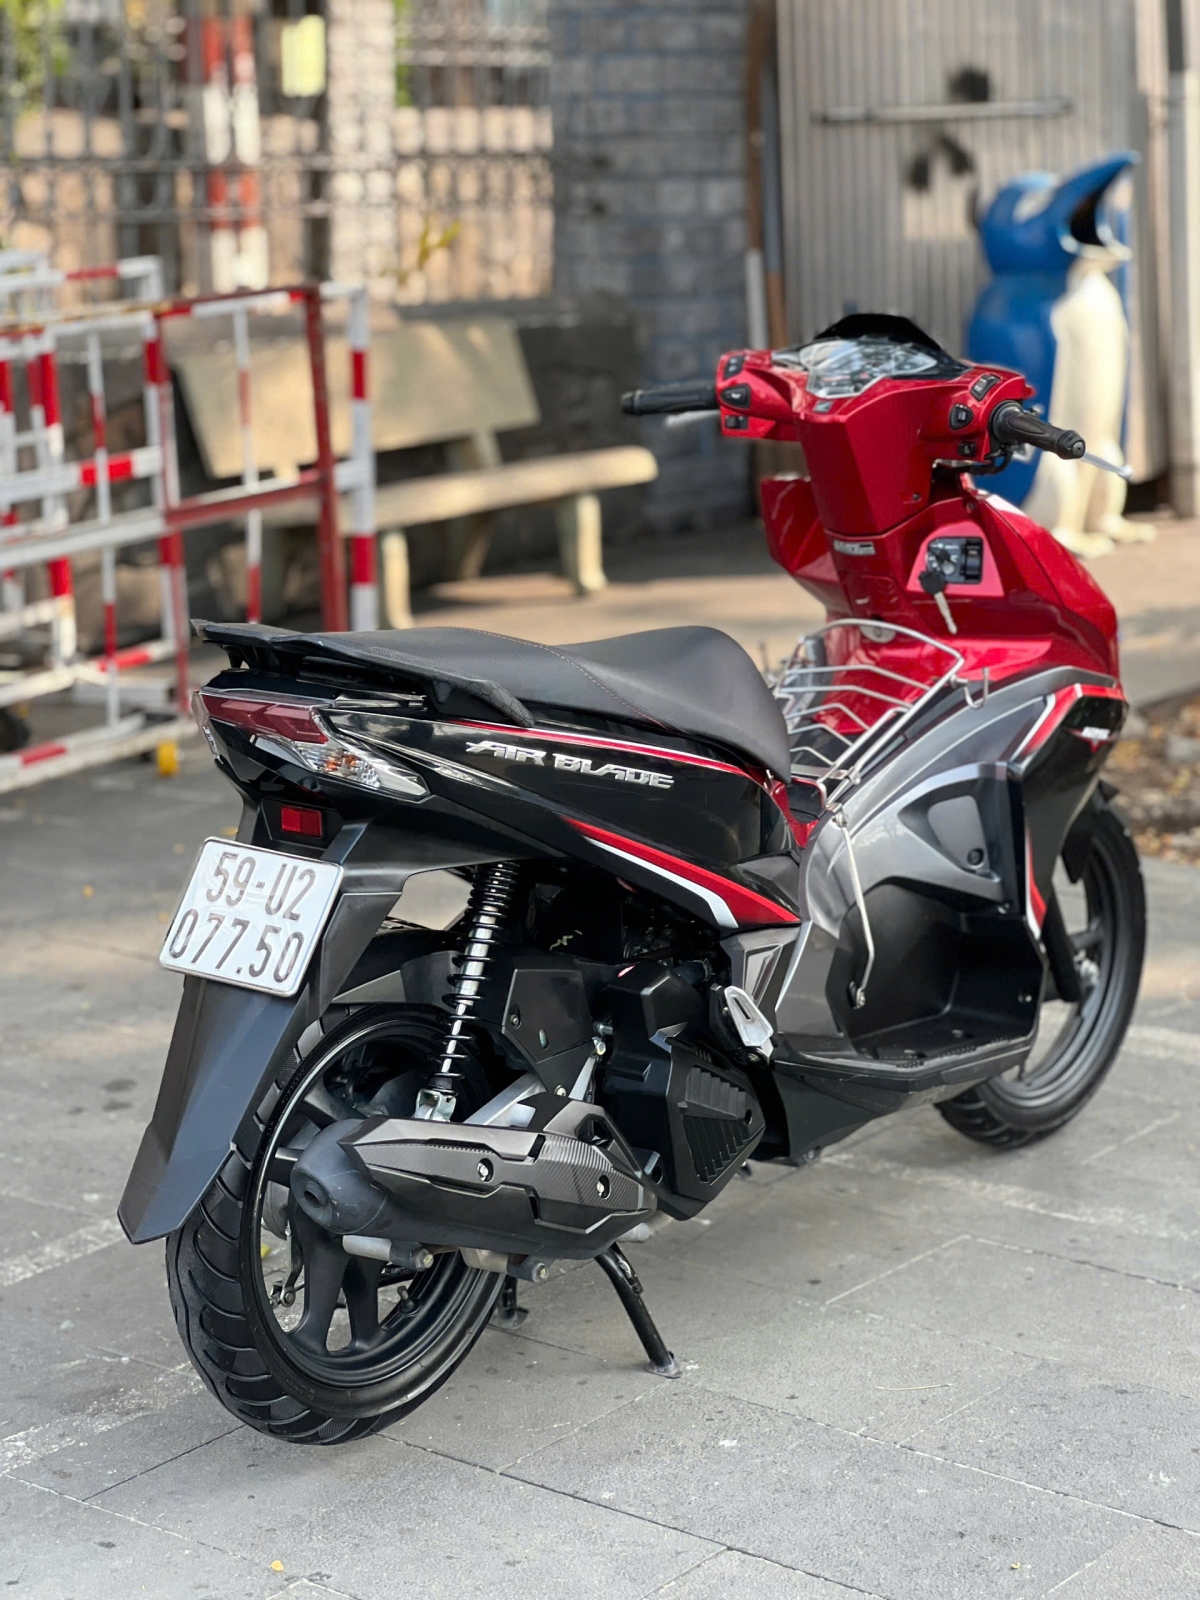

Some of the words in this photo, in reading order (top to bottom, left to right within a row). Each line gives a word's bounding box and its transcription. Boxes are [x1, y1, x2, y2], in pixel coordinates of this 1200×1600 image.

[465, 740, 547, 767] AIR
[552, 753, 675, 789] BLADE
[206, 851, 316, 921] 59-U2
[169, 908, 304, 983] 077.50
